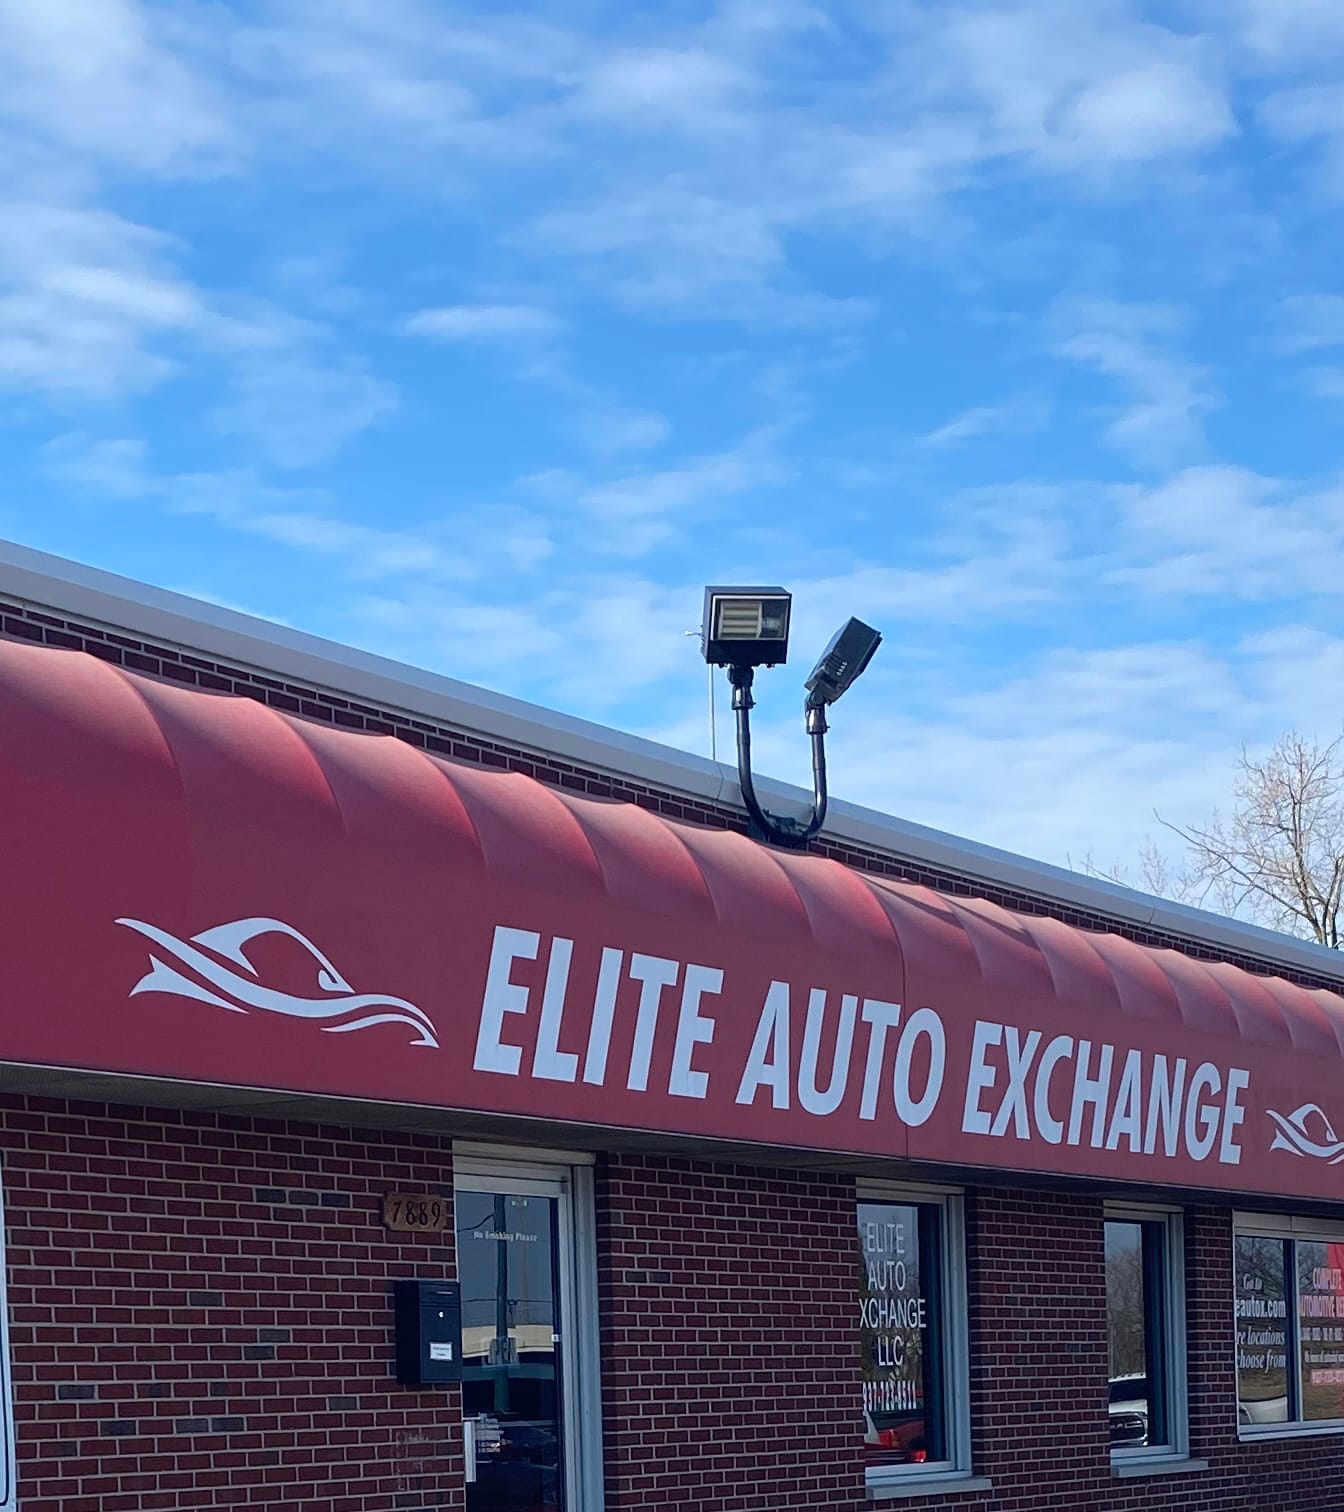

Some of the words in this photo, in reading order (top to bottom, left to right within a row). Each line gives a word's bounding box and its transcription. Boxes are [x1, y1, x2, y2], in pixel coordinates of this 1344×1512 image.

[473, 925, 724, 1098] ELITE
[736, 980, 946, 1127] AUTO
[961, 1020, 1250, 1164] EXCHANGE
[393, 1202, 440, 1227] 7889
[473, 1231, 484, 1240] No
[485, 1231, 514, 1242] Smoking
[867, 1223, 905, 1254] ELITE
[868, 1260, 906, 1291] AUTO
[859, 1298, 927, 1328] XCHANGE
[1235, 1295, 1286, 1317] eautox.com
[1299, 1295, 1335, 1317] UTOMOTIVE
[1236, 1331, 1246, 1345] re
[1247, 1325, 1286, 1345] locations
[877, 1336, 904, 1366] LLC
[1264, 1349, 1286, 1373] from
